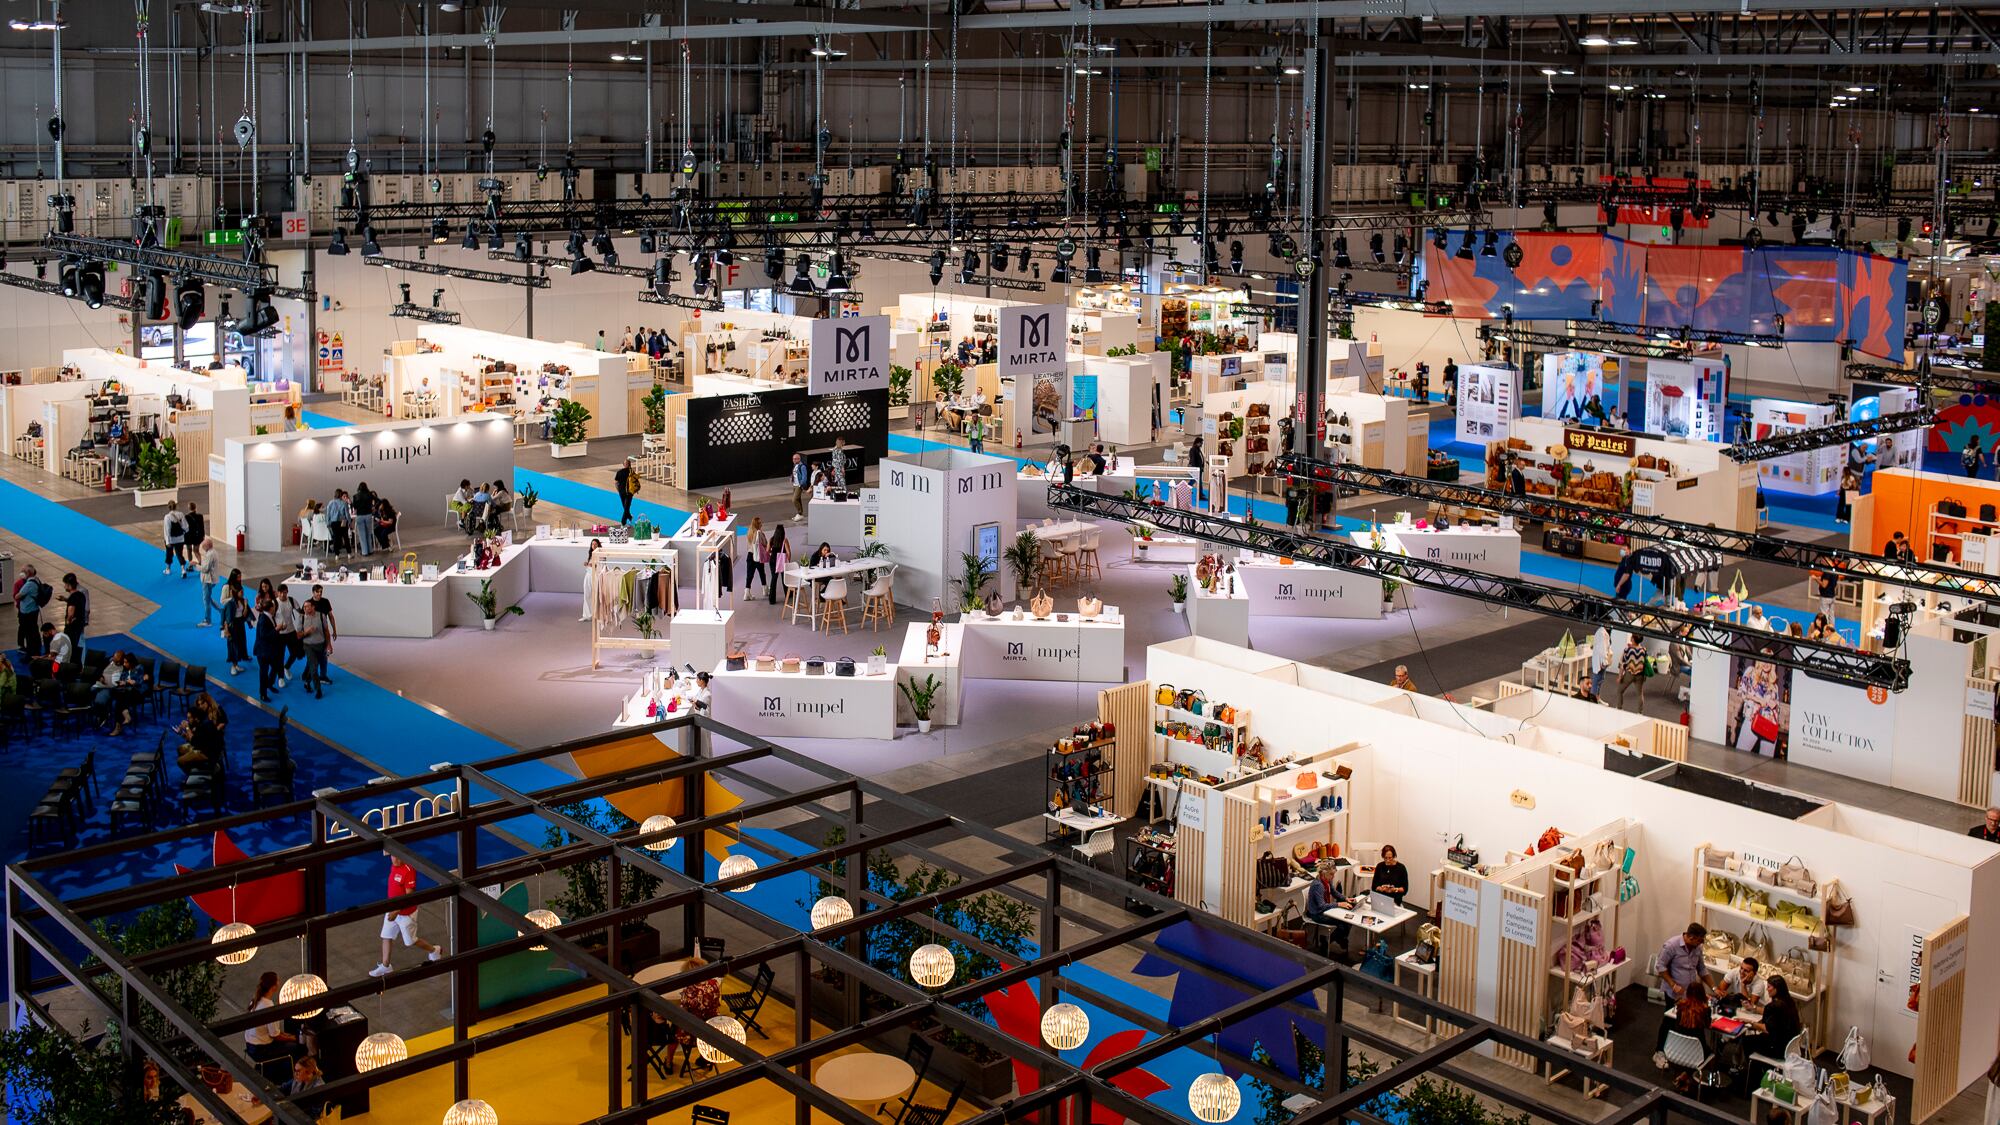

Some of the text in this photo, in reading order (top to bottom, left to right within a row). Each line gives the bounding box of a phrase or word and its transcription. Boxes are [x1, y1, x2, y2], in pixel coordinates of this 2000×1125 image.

[286, 219, 306, 233] 3E
[1010, 351, 1057, 366] MIRTA
[824, 367, 880, 383] MIRTA
[723, 395, 762, 408] FASHION
[379, 437, 432, 465] mipel
[1587, 435, 1628, 452] Pratesi
[335, 463, 366, 472] MIRTA
[1451, 549, 1486, 564] mipel
[1305, 585, 1343, 601] mipel
[1037, 644, 1080, 662] mipel
[797, 698, 844, 718] mipel
[1803, 711, 1830, 727] NEW
[1802, 725, 1875, 751] COLLECTION
[1744, 852, 1755, 863] DI
[1506, 920, 1533, 933] Campania
[1511, 929, 1534, 941] Lorenzo
[1912, 934, 1923, 949] DI
